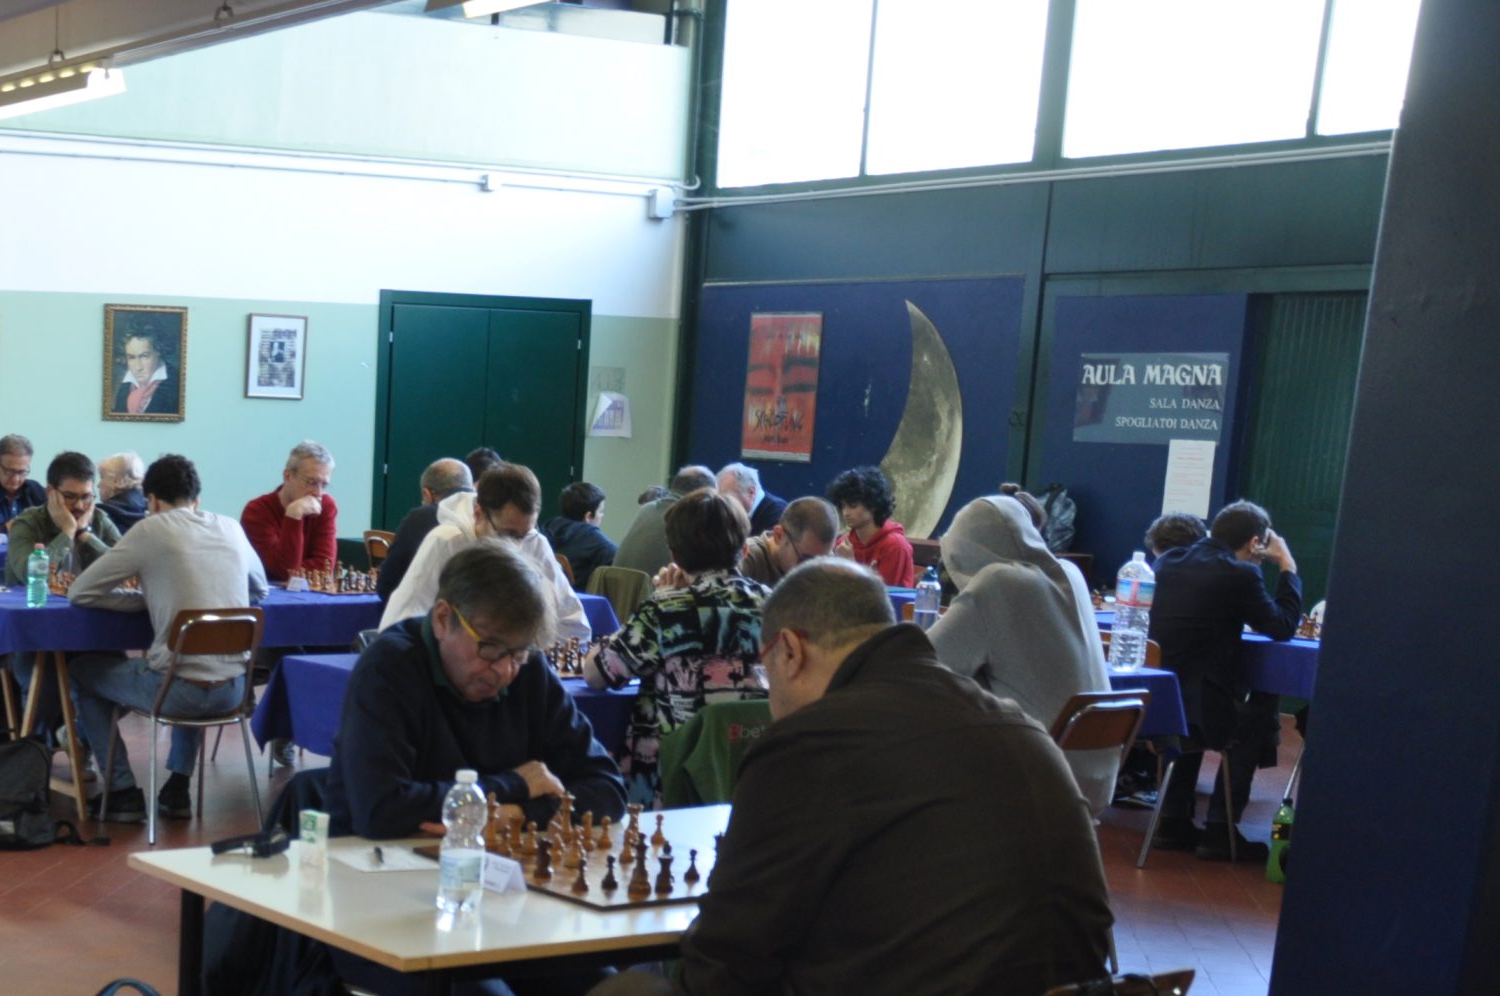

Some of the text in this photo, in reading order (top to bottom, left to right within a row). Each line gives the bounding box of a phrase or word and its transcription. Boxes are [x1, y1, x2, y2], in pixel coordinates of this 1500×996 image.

[1082, 364, 1222, 386] AULA MAGNA
[1149, 398, 1220, 410] SALA DANZA
[1116, 416, 1219, 430] SPOGLIATOI DANZA
